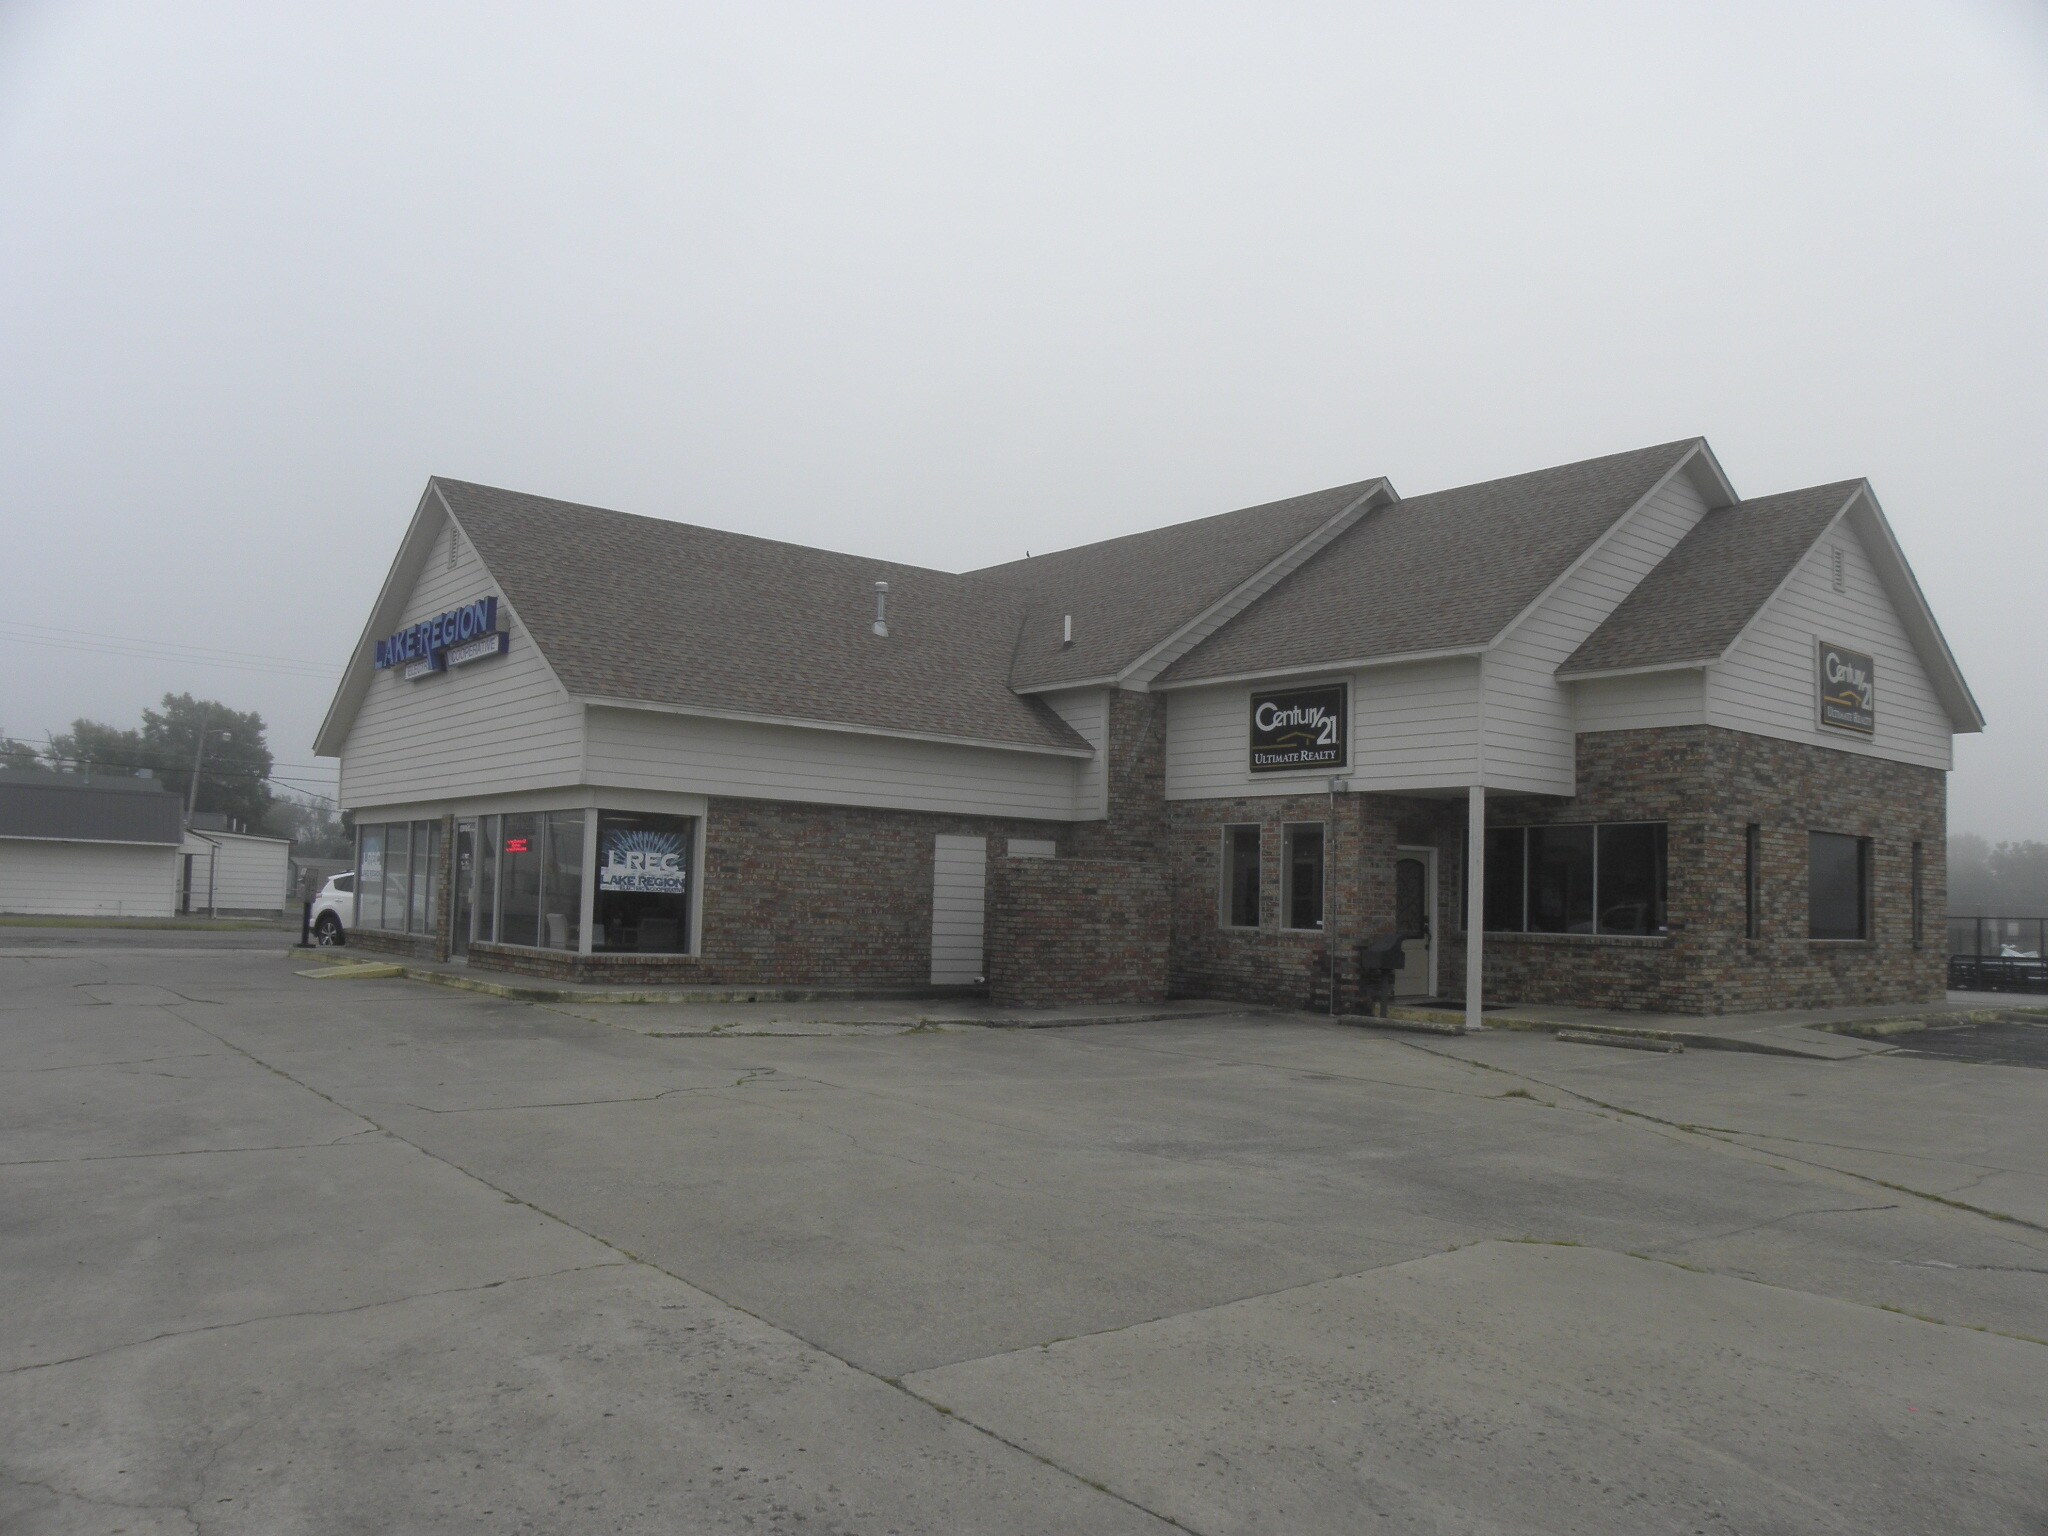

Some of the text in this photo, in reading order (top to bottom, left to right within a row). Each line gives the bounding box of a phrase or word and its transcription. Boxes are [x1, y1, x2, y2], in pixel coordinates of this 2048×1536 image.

[375, 597, 496, 670] LAKE REGION
[1255, 702, 1325, 731] Century
[1317, 715, 1337, 745] 21
[1255, 750, 1336, 764] ULTIMATE REALTY
[608, 849, 681, 872] LREC
[600, 875, 635, 886] LAKE
[637, 875, 685, 889] REGION
